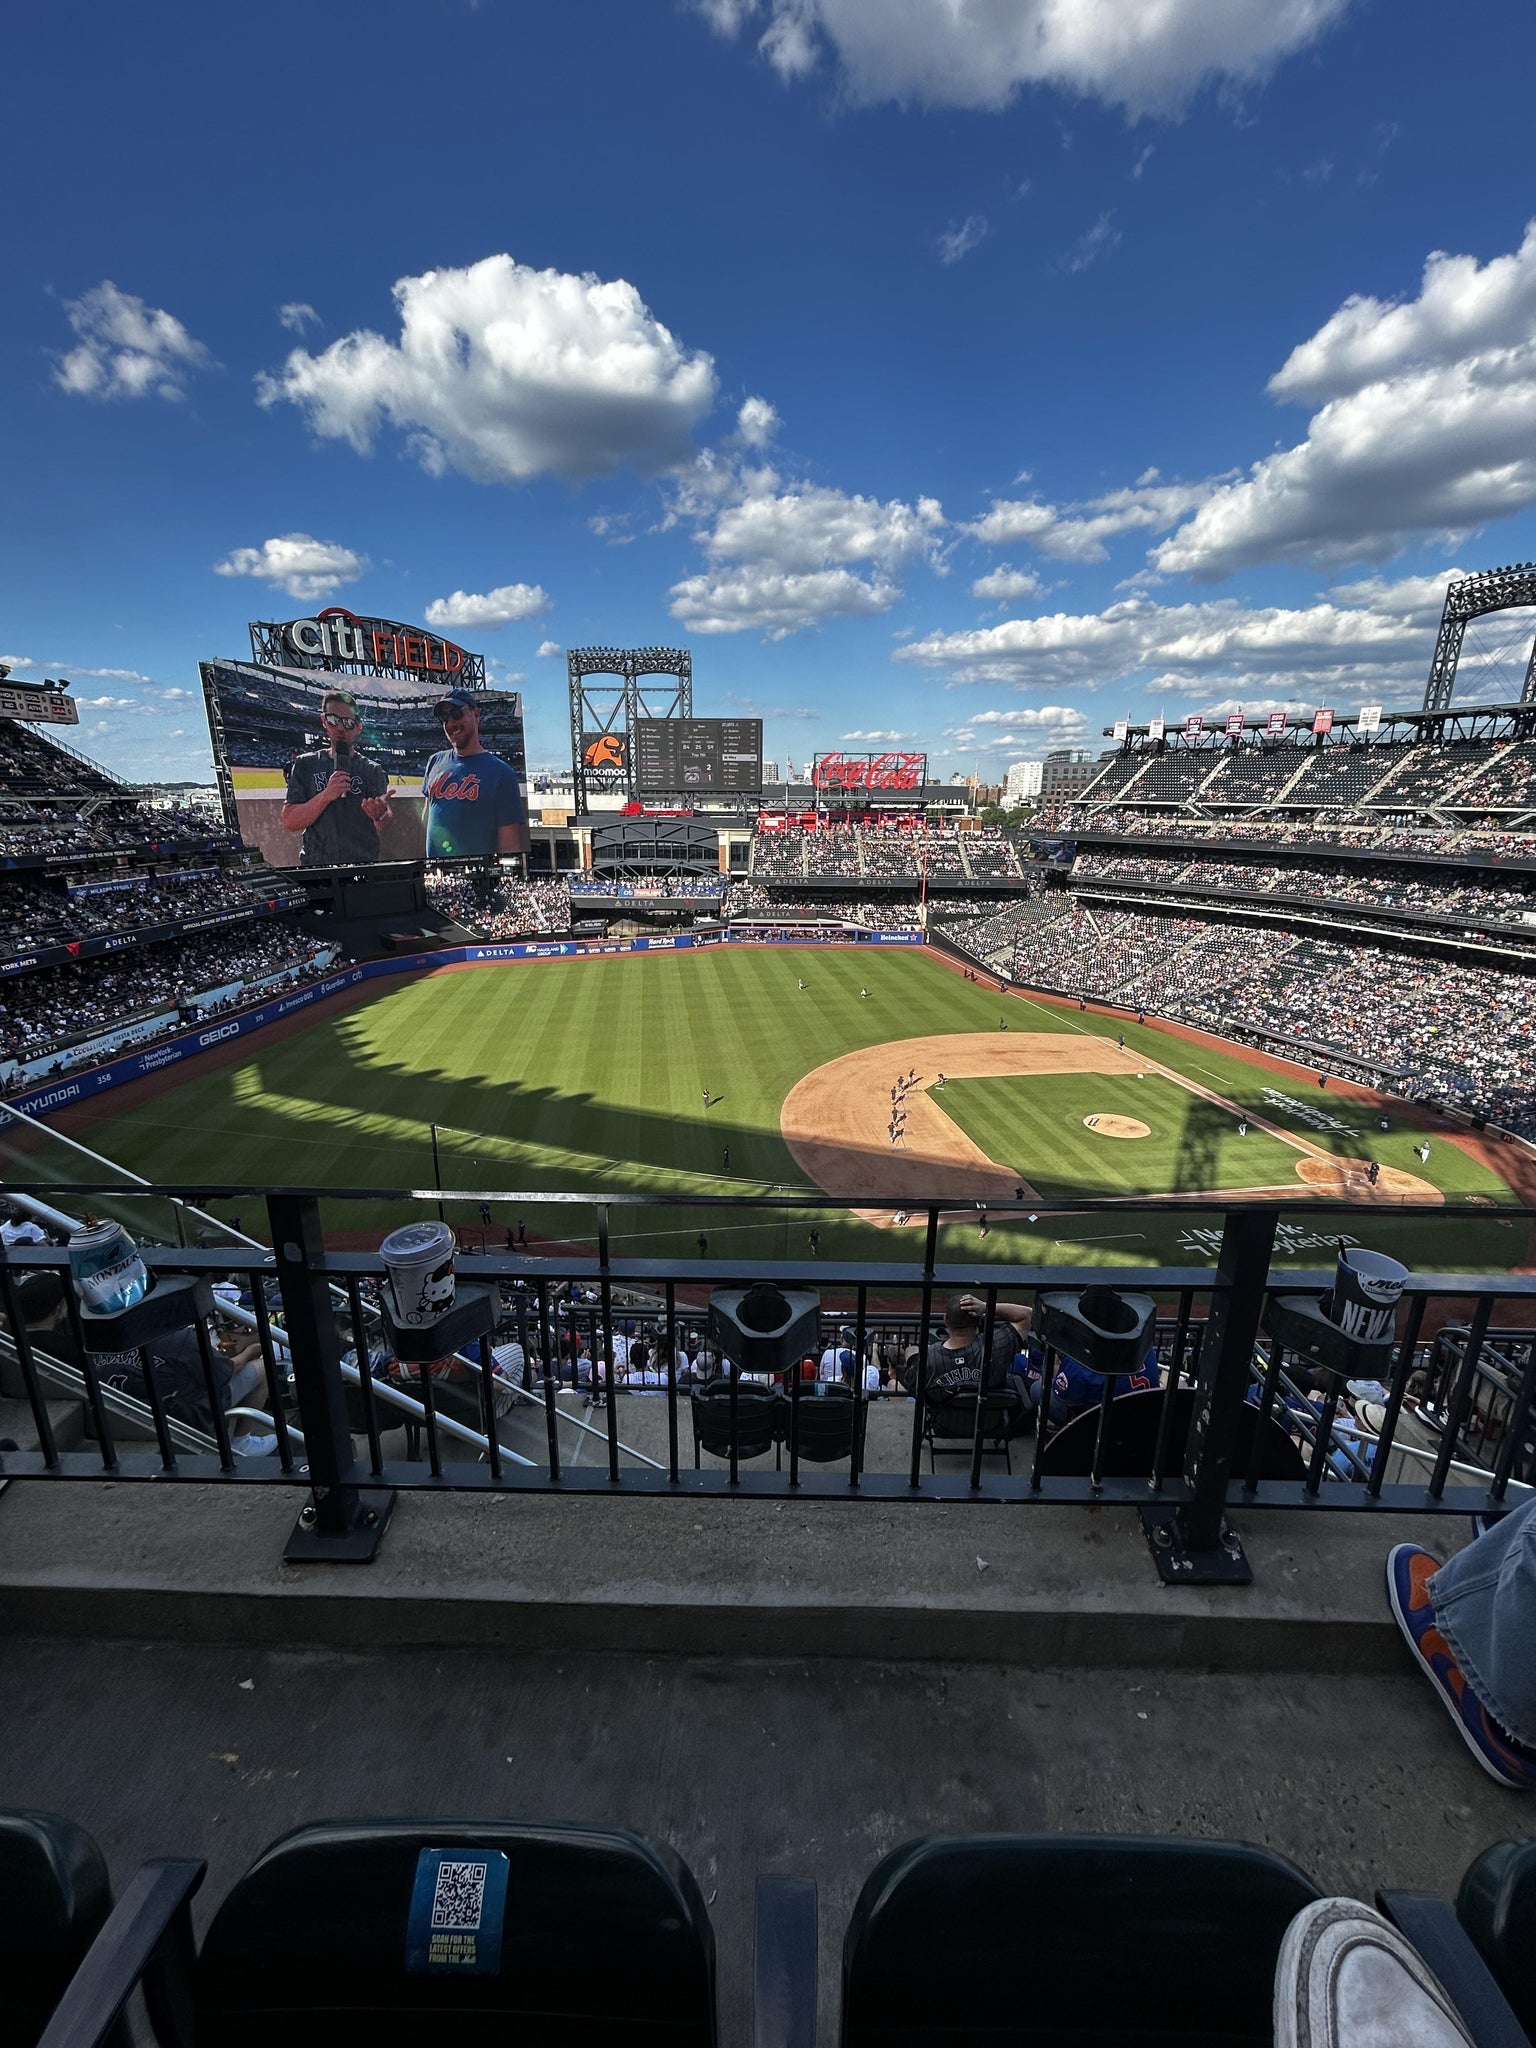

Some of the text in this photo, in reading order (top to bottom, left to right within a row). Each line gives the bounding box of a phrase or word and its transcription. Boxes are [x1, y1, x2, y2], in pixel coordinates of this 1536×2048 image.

[292, 616, 464, 672] citi FIELD
[583, 768, 627, 776] moomoo
[429, 771, 480, 801] Mets
[113, 935, 137, 947] DELTA
[486, 948, 514, 956] DELTA
[1, 957, 37, 971] YORK METS
[256, 969, 272, 979] DELTA
[325, 978, 346, 991] Guardian
[131, 1026, 145, 1035] DECK
[199, 1021, 240, 1047] GEICO
[32, 1044, 58, 1057] DELTA
[145, 1051, 182, 1070] Presbyterian
[97, 1073, 112, 1085] 358
[20, 1084, 81, 1114] HYUNDAI
[87, 1251, 142, 1290] MONTAUK
[431, 1934, 476, 1945] SCAN FOR THE
[430, 1943, 476, 1954] LATEST OFFERS
[429, 1953, 448, 1963] FROM
[448, 1954, 460, 1963] THE
